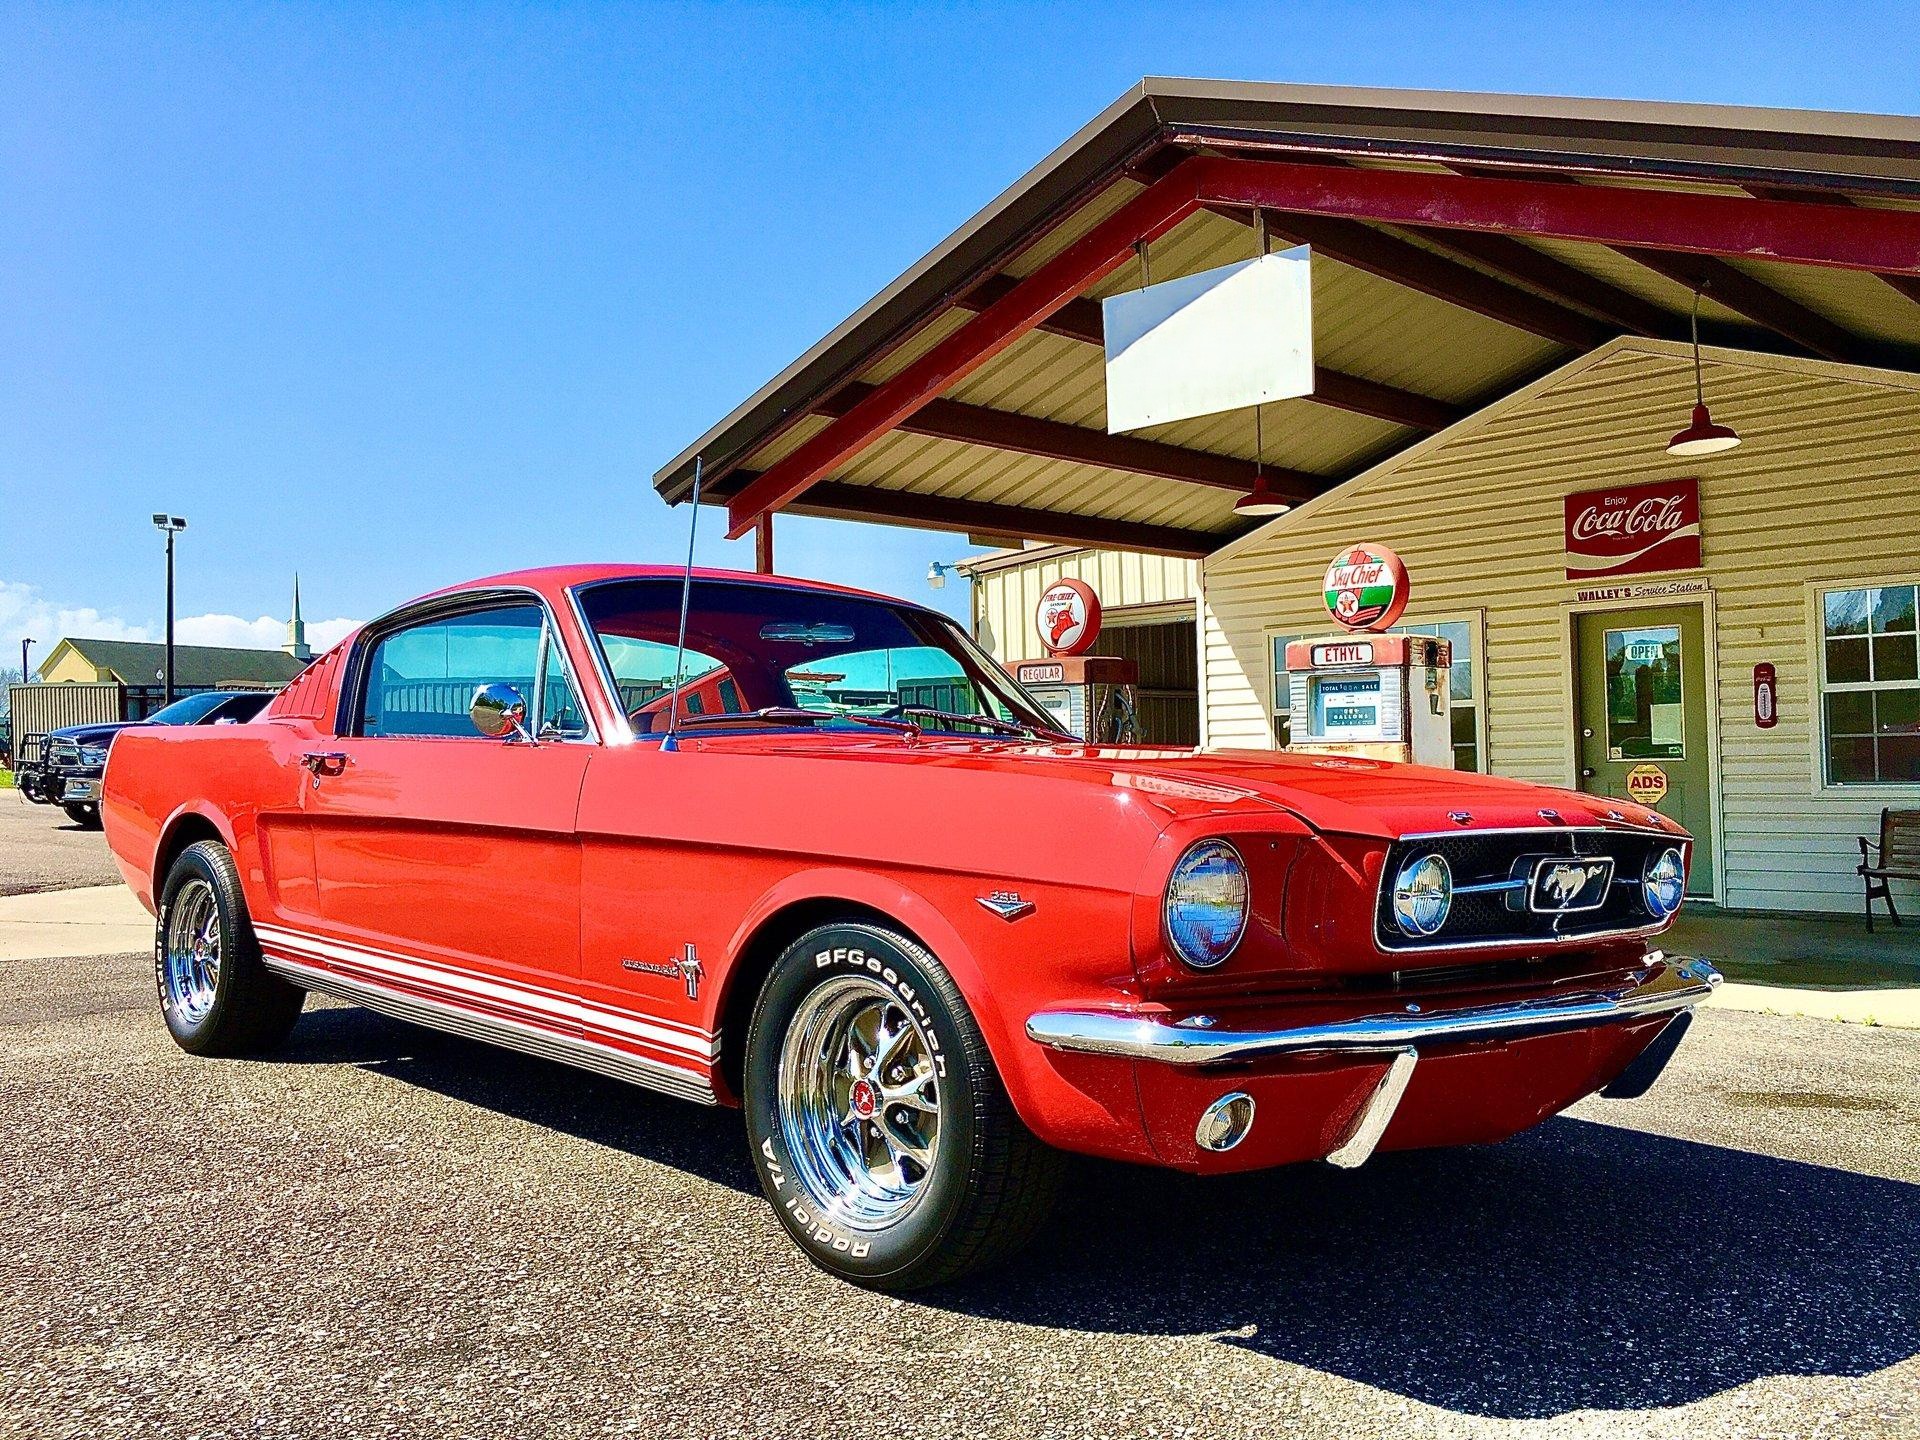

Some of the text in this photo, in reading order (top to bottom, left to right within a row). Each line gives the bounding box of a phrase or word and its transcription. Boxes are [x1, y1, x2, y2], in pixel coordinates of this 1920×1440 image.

[1604, 496, 1628, 506] Enjoy
[1572, 494, 1687, 540] Coca-Cola
[1331, 564, 1383, 588] Sky Chief
[1577, 582, 1704, 602] WALLEY'S Service Station
[1325, 647, 1362, 662] ETHYL
[1631, 644, 1659, 659] OPEN
[1023, 667, 1060, 681] REGULAR
[1630, 775, 1664, 789] ADS
[816, 948, 947, 1078] BFGoodrich
[761, 1136, 872, 1259] Radial T/A
